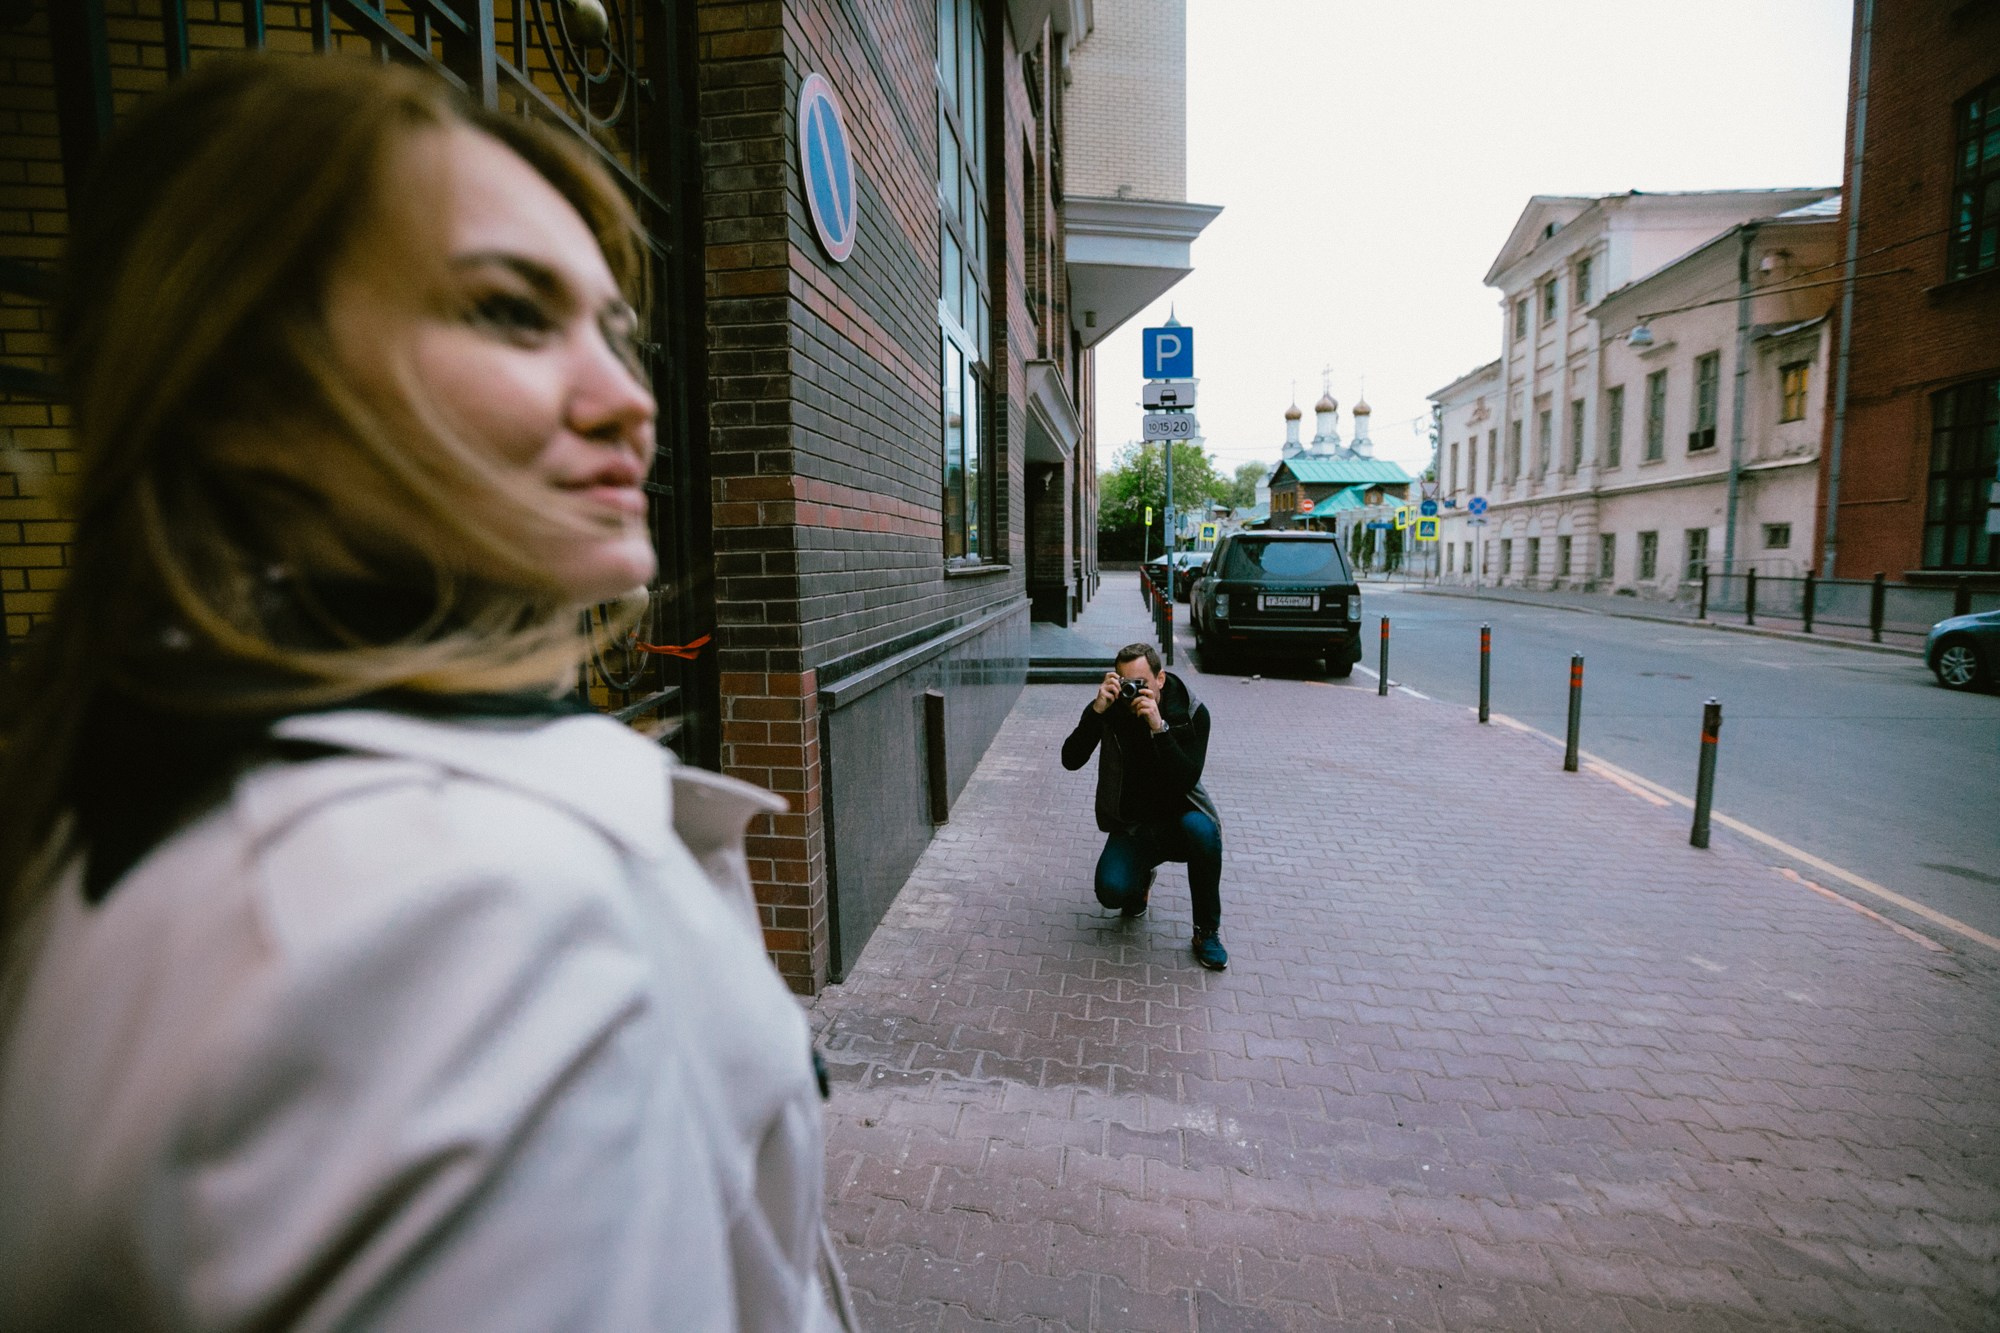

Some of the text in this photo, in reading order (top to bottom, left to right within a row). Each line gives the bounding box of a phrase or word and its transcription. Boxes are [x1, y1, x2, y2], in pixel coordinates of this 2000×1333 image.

[1156, 334, 1182, 372] P
[1148, 421, 1188, 432] 10 15 20
